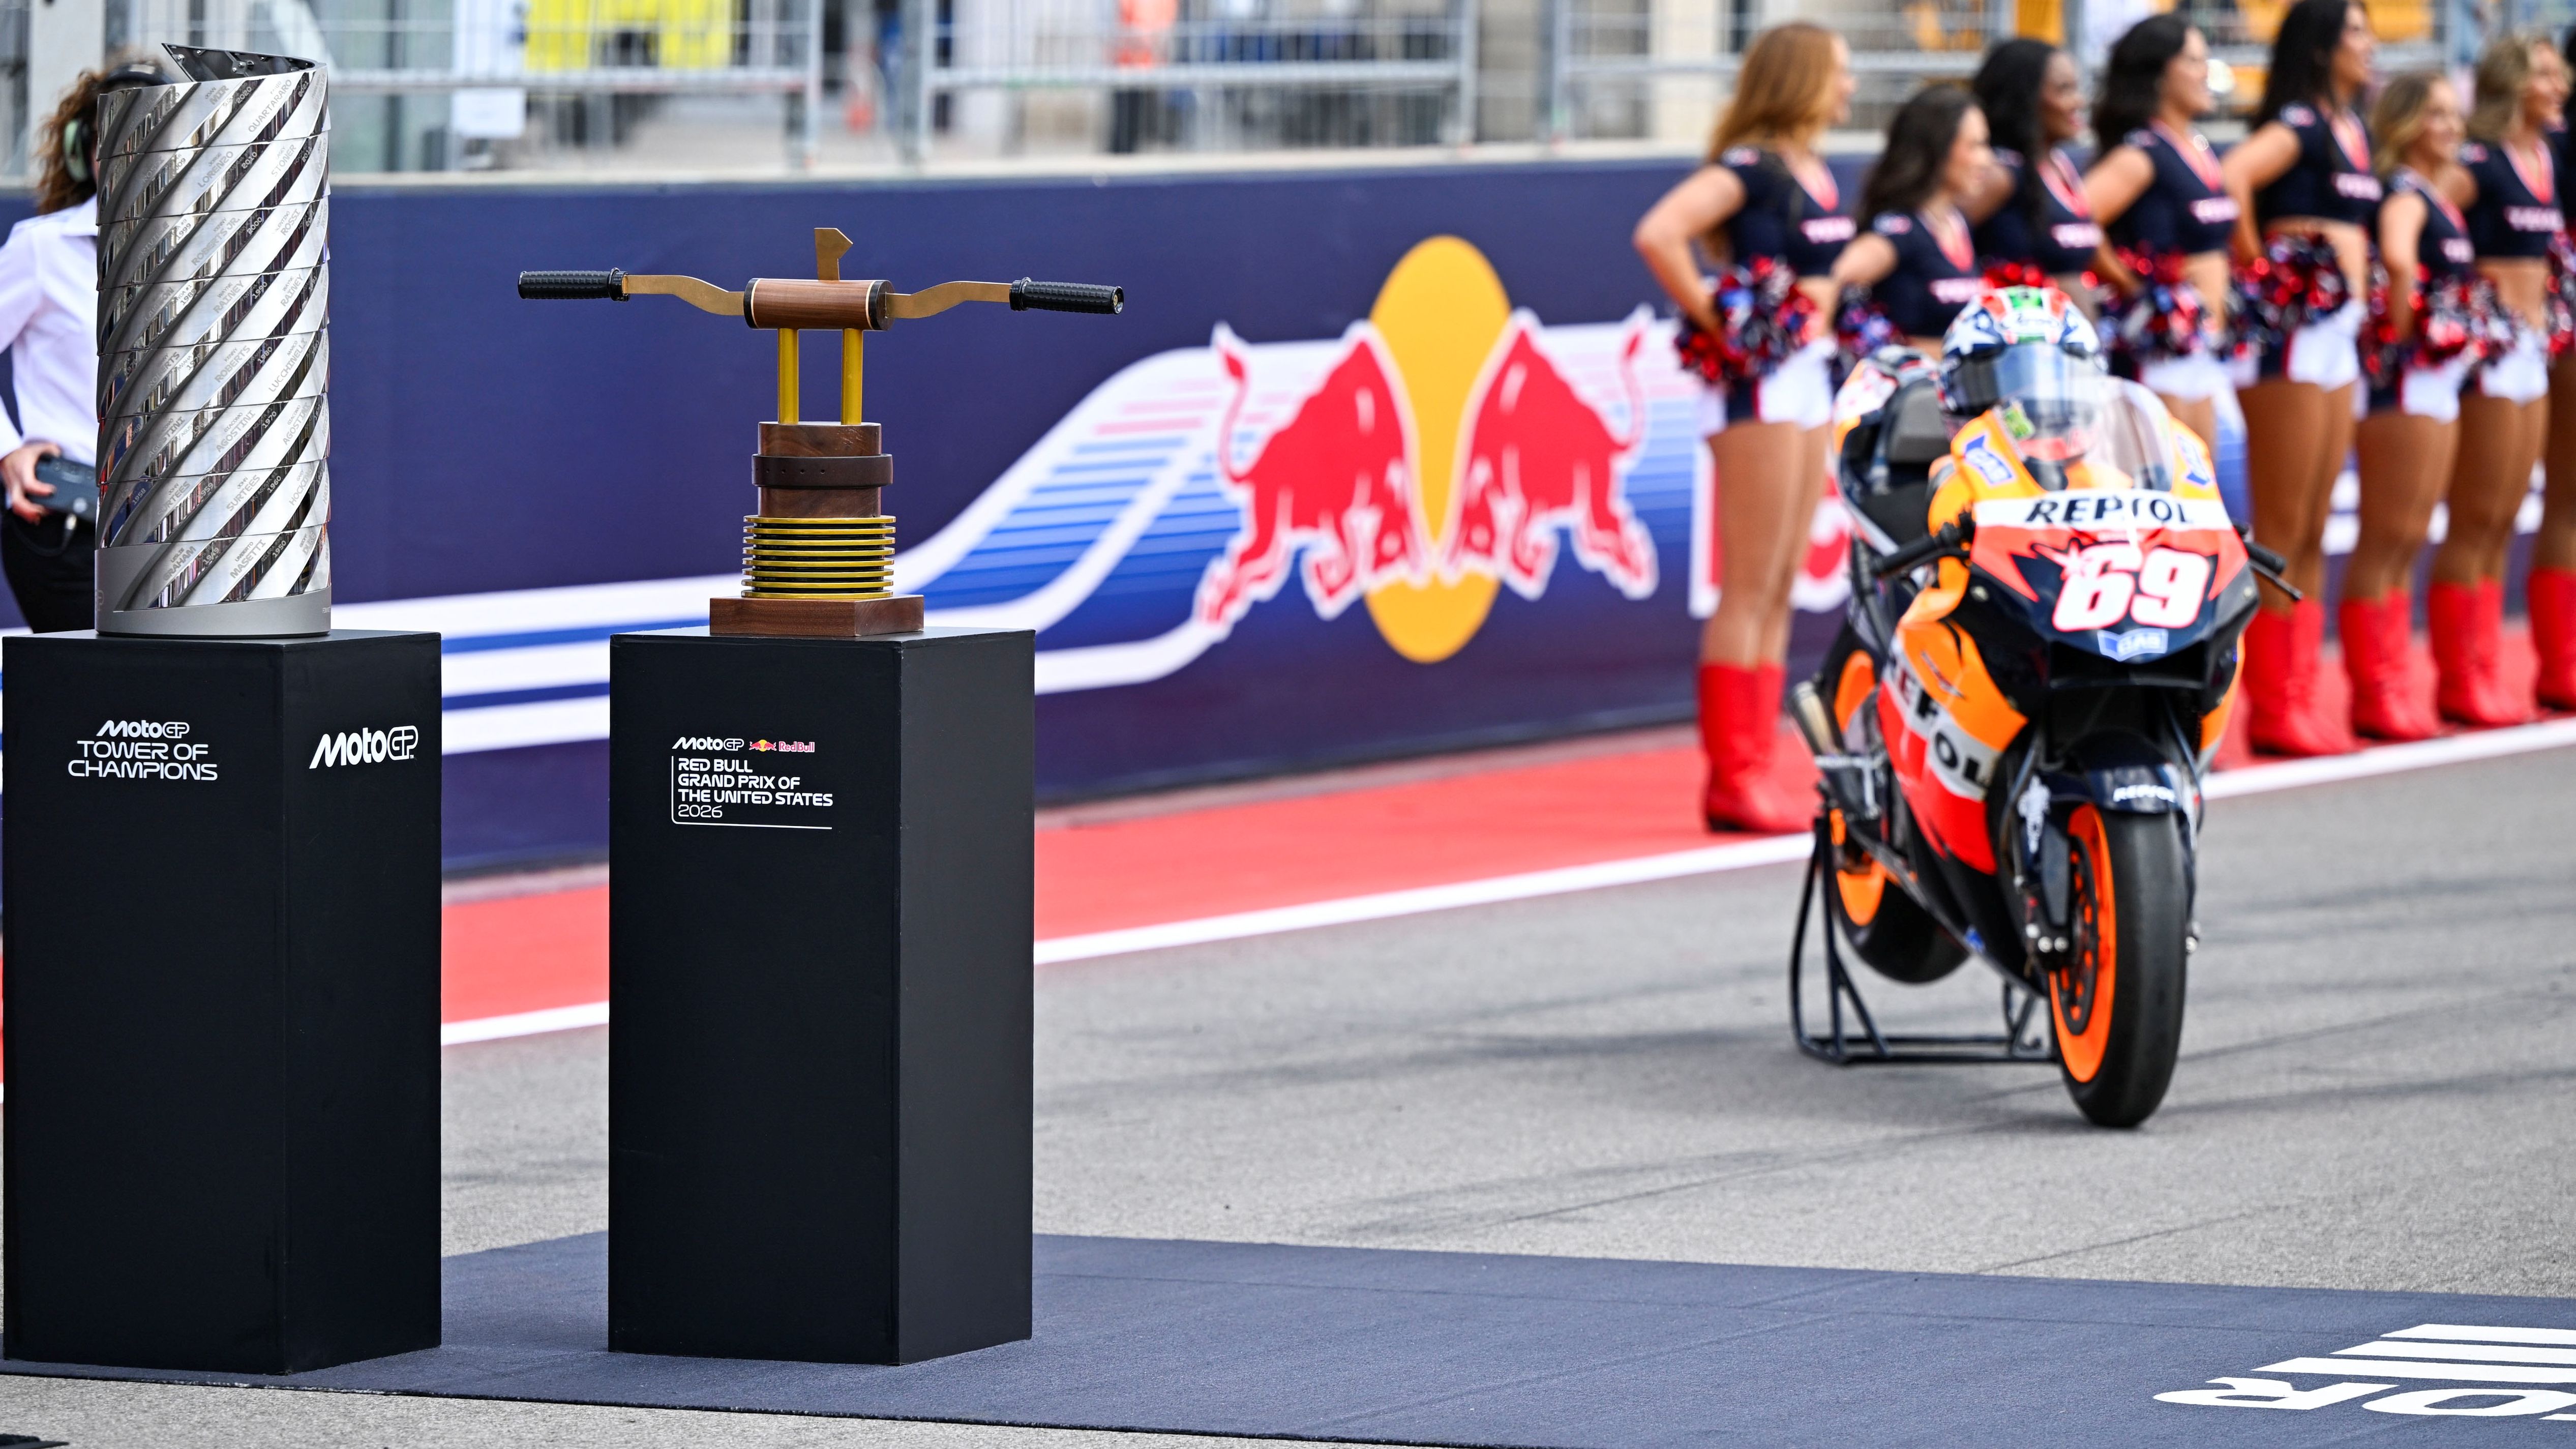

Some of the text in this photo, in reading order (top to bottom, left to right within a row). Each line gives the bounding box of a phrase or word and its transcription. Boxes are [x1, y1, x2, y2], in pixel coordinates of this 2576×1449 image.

[209, 85, 228, 105] MIR
[236, 86, 252, 104] 2020
[248, 79, 291, 132] QUARTARARO
[198, 151, 233, 188] LORENZO
[242, 152, 257, 169] 2010
[271, 144, 296, 177] STONER
[176, 223, 191, 240] 1999
[247, 217, 262, 234] 2000
[281, 209, 301, 235] ROSSI
[191, 230, 228, 265] ROBERTS
[227, 217, 241, 233] JR.
[180, 288, 196, 306] 1989
[213, 281, 244, 313] RAINEY
[217, 283, 233, 298] WAYNE
[252, 282, 267, 299] 1990
[281, 274, 303, 306] RAINEY
[257, 346, 273, 364] 1980
[287, 340, 297, 356] MARCO
[214, 345, 251, 382] ROBERTS
[268, 338, 307, 392] LUCCHINELLI
[224, 412, 243, 432] GIACOMO
[262, 411, 277, 429] 1970
[287, 405, 301, 425] GIACOMO
[216, 410, 255, 452] AGOSTINI
[168, 483, 179, 495] JOHN
[227, 475, 260, 511] SURTEES
[237, 477, 248, 489] JOHN
[267, 476, 282, 493] 1960
[133, 488, 146, 505] 1958
[158, 481, 190, 515] SURTEES
[235, 541, 253, 562] UMBERTO
[273, 540, 286, 558] 1950
[163, 546, 196, 581] GRAHAM
[230, 540, 266, 579] MASETTI
[2052, 539, 2210, 632] 69
[96, 720, 190, 738] MotoGP
[77, 741, 208, 761] TOWER OF
[309, 725, 418, 770] MotoGP
[672, 737, 744, 751] MotoGP
[68, 760, 218, 781] CHAMPIONS
[678, 757, 753, 773] RED BULL
[678, 774, 800, 789] GRAND PRIX OF
[678, 789, 833, 807] THE UNITED STATES
[678, 804, 723, 818] 2026
